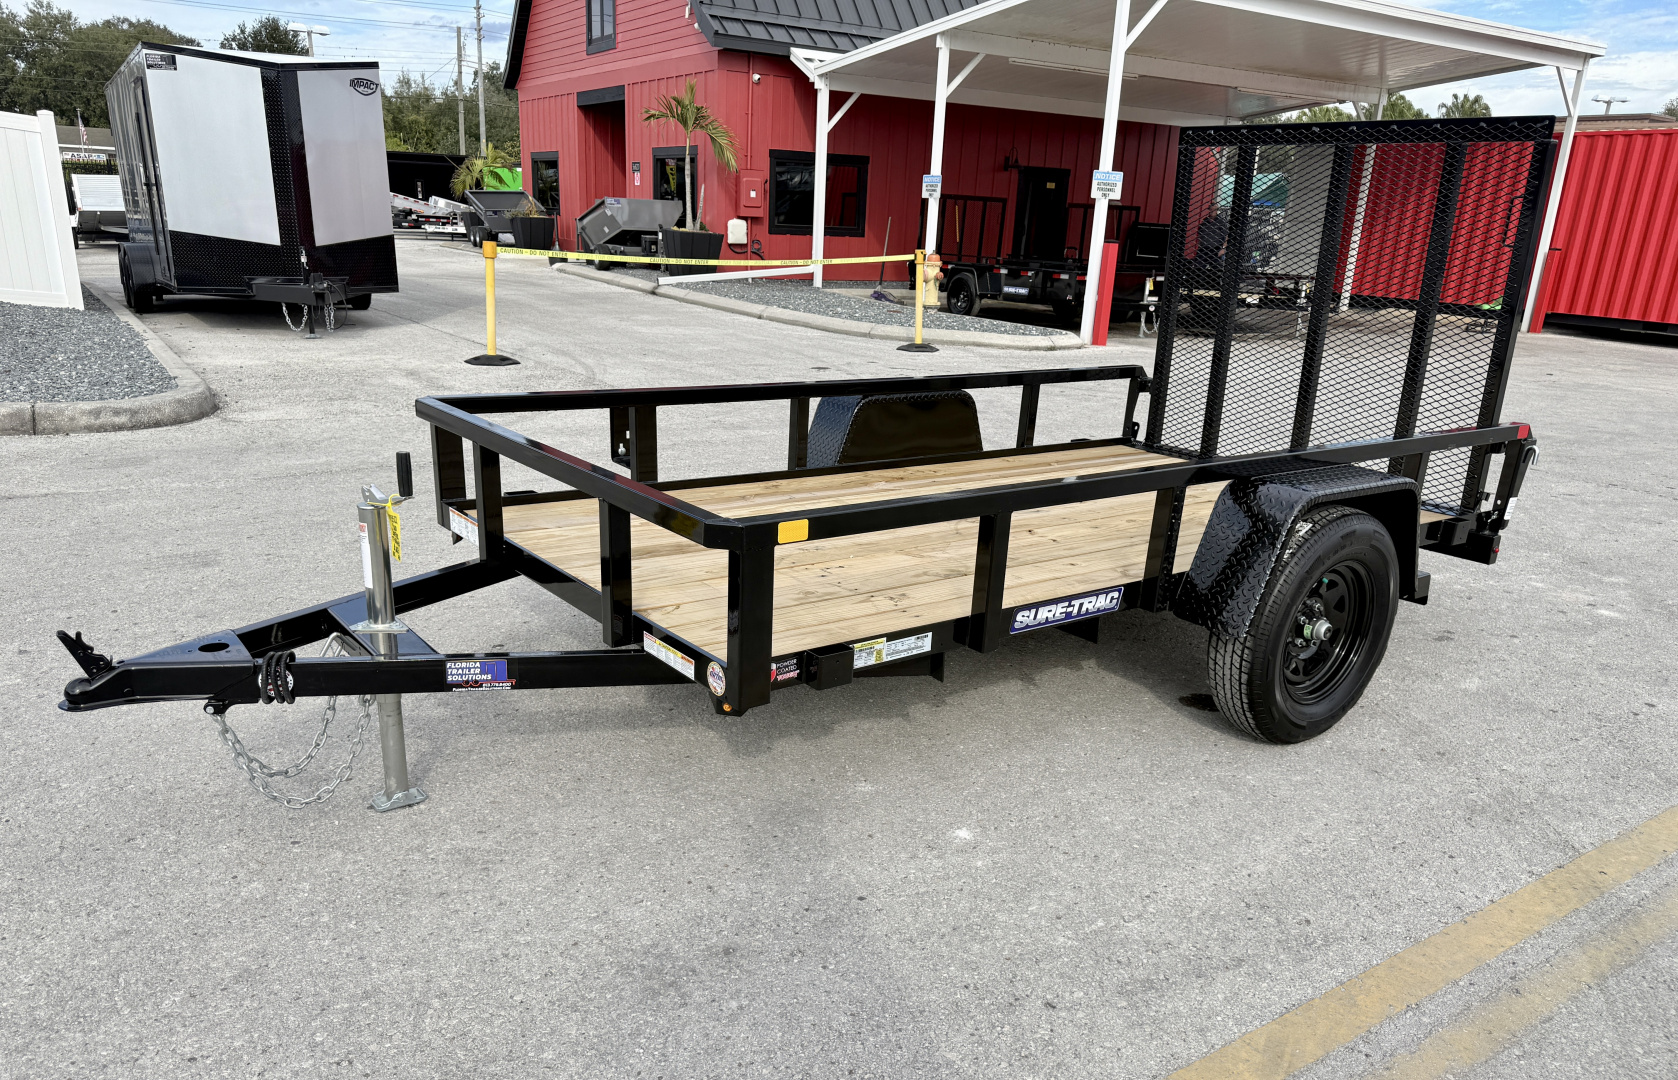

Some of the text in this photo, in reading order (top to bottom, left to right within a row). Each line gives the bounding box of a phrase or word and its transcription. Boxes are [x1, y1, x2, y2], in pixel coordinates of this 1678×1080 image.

[350, 79, 379, 90] IMPACT
[1014, 591, 1119, 629] SURE-TRAC
[777, 658, 797, 668] POWDER
[777, 665, 797, 674] COATED
